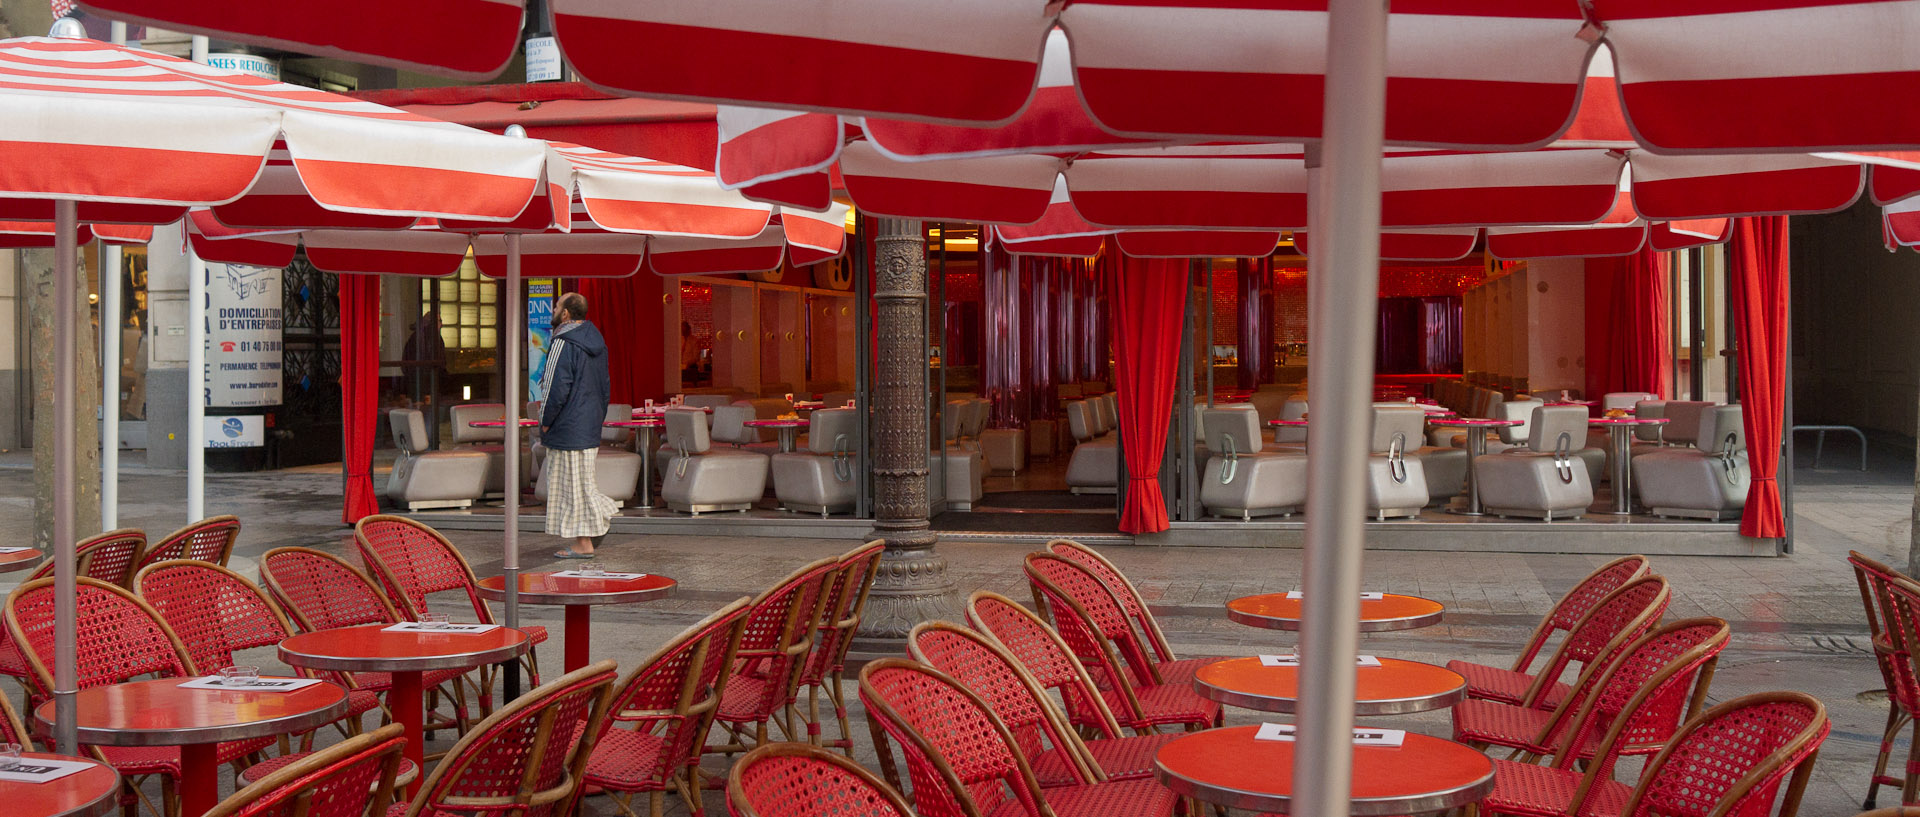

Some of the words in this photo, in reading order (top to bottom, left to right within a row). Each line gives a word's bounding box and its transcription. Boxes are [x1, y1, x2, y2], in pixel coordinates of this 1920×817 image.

[219, 308, 281, 318] DOMICILIATION
[219, 320, 281, 330] D'ENTREPRISES
[241, 341, 250, 352] 01
[252, 341, 261, 352] 40
[220, 362, 258, 371] PERMANENCE
